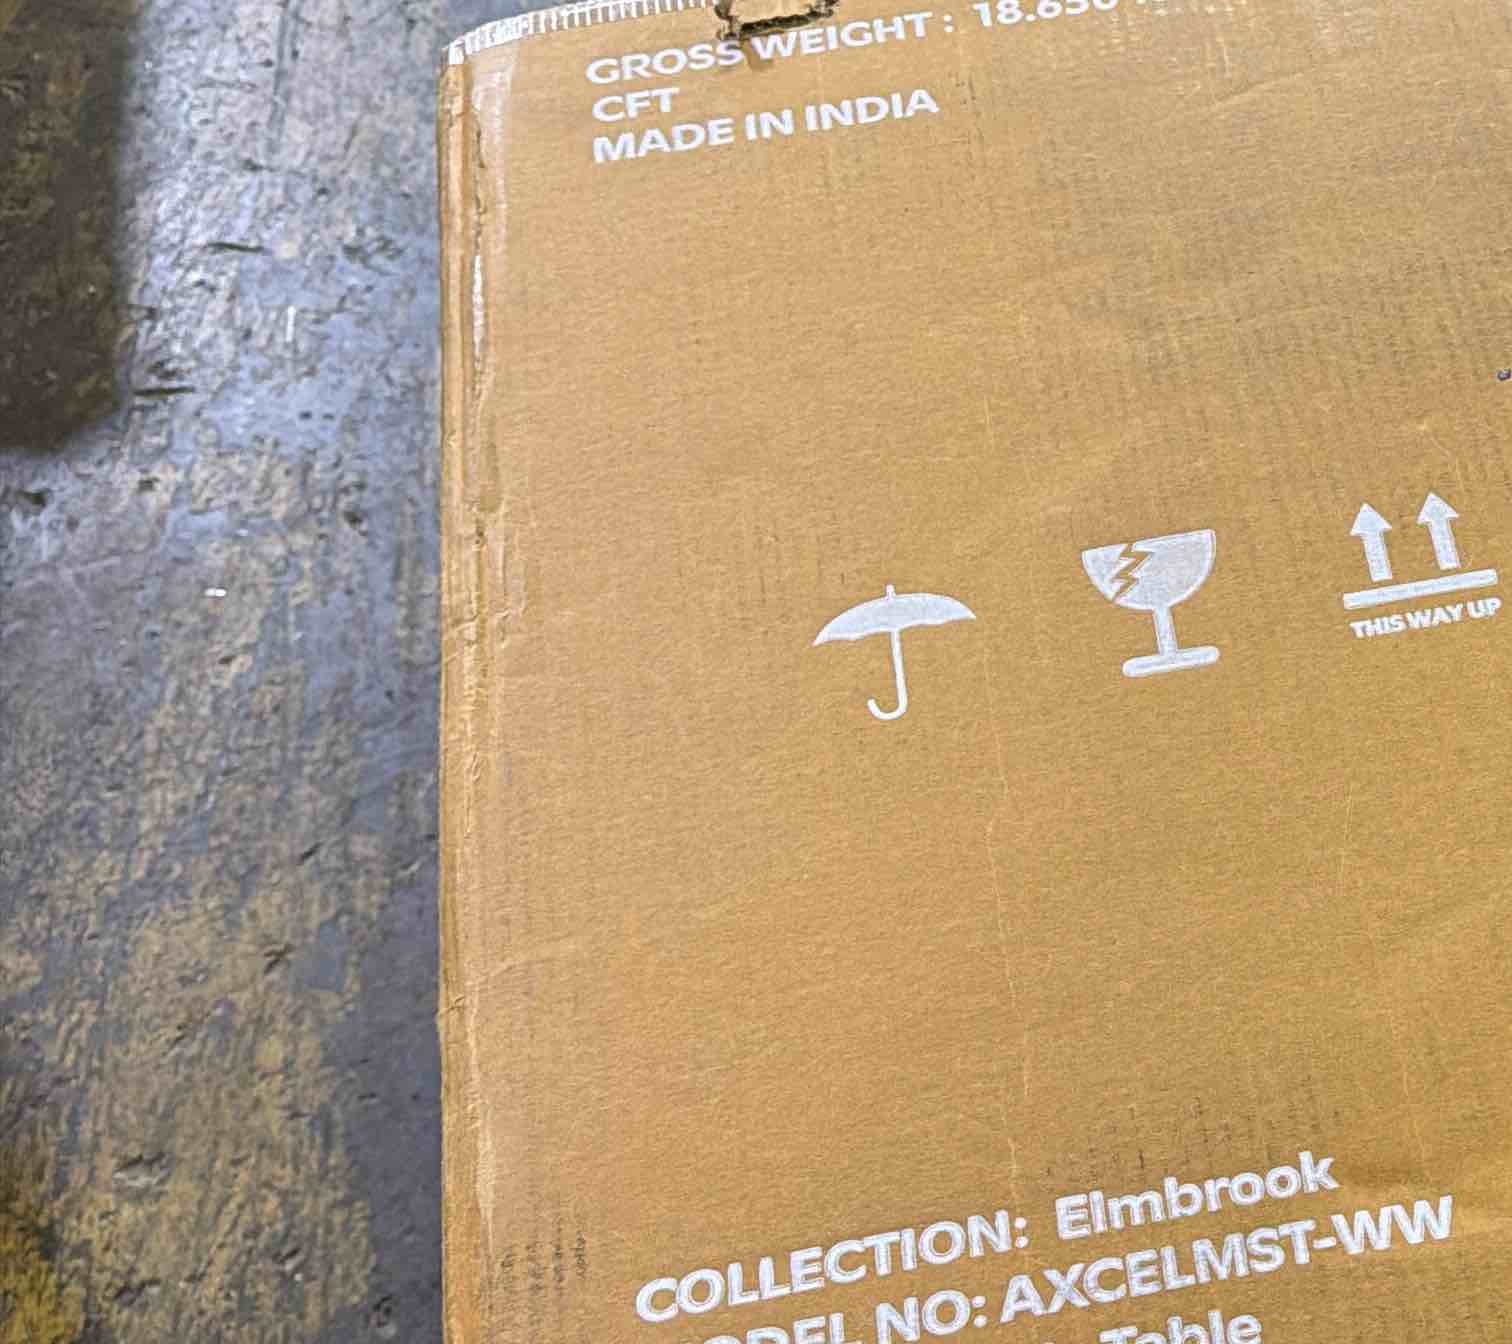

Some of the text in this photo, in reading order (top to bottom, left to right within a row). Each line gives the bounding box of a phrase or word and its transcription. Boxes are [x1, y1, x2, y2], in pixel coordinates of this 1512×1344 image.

[585, 38, 744, 86] GROSS
[591, 86, 680, 123] CFT
[592, 88, 940, 164] MADE IN INDIA
[1349, 595, 1503, 639] THIS WAY UP
[634, 1150, 1340, 1324] COLLECTION: Elmbrook
[999, 1194, 1455, 1325] AXCELMST-WW
